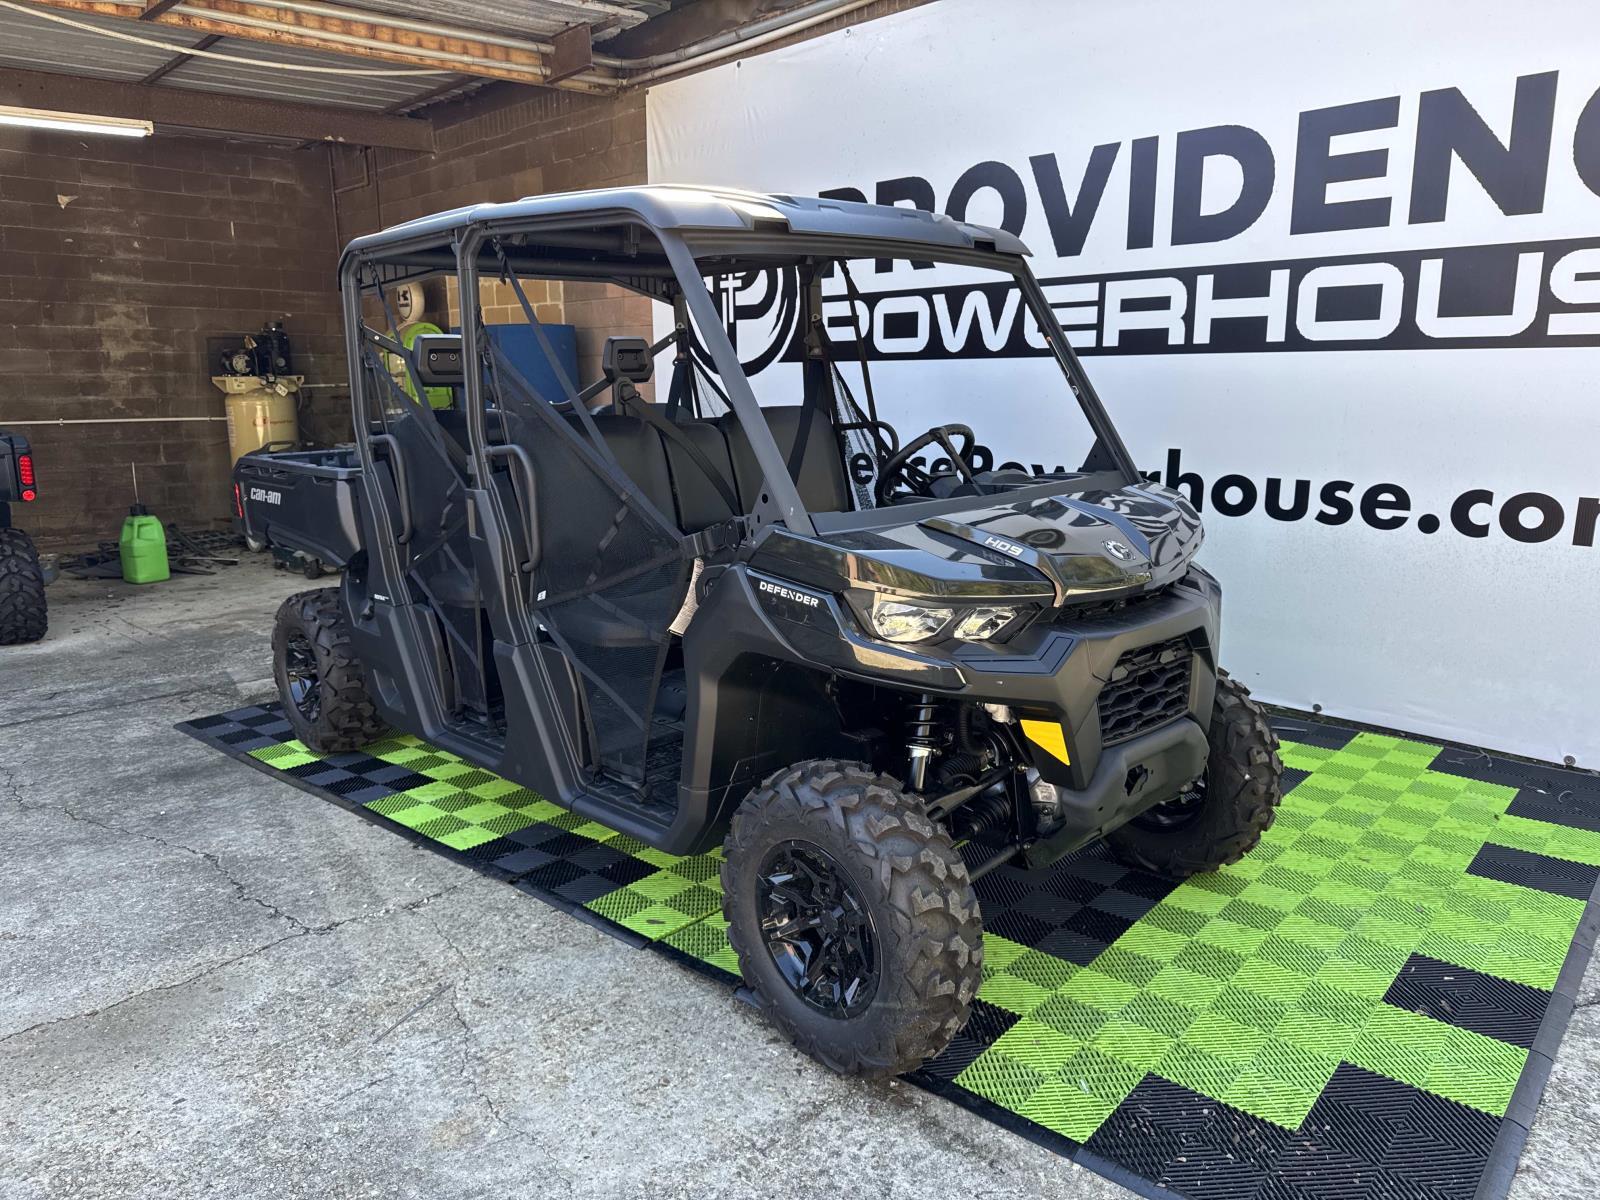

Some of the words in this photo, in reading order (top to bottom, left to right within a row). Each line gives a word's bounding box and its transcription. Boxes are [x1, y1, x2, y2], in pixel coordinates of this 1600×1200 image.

[819, 70, 1600, 278] OVIDEN
[250, 487, 282, 505] can-am
[759, 580, 819, 608] DEFENDER
